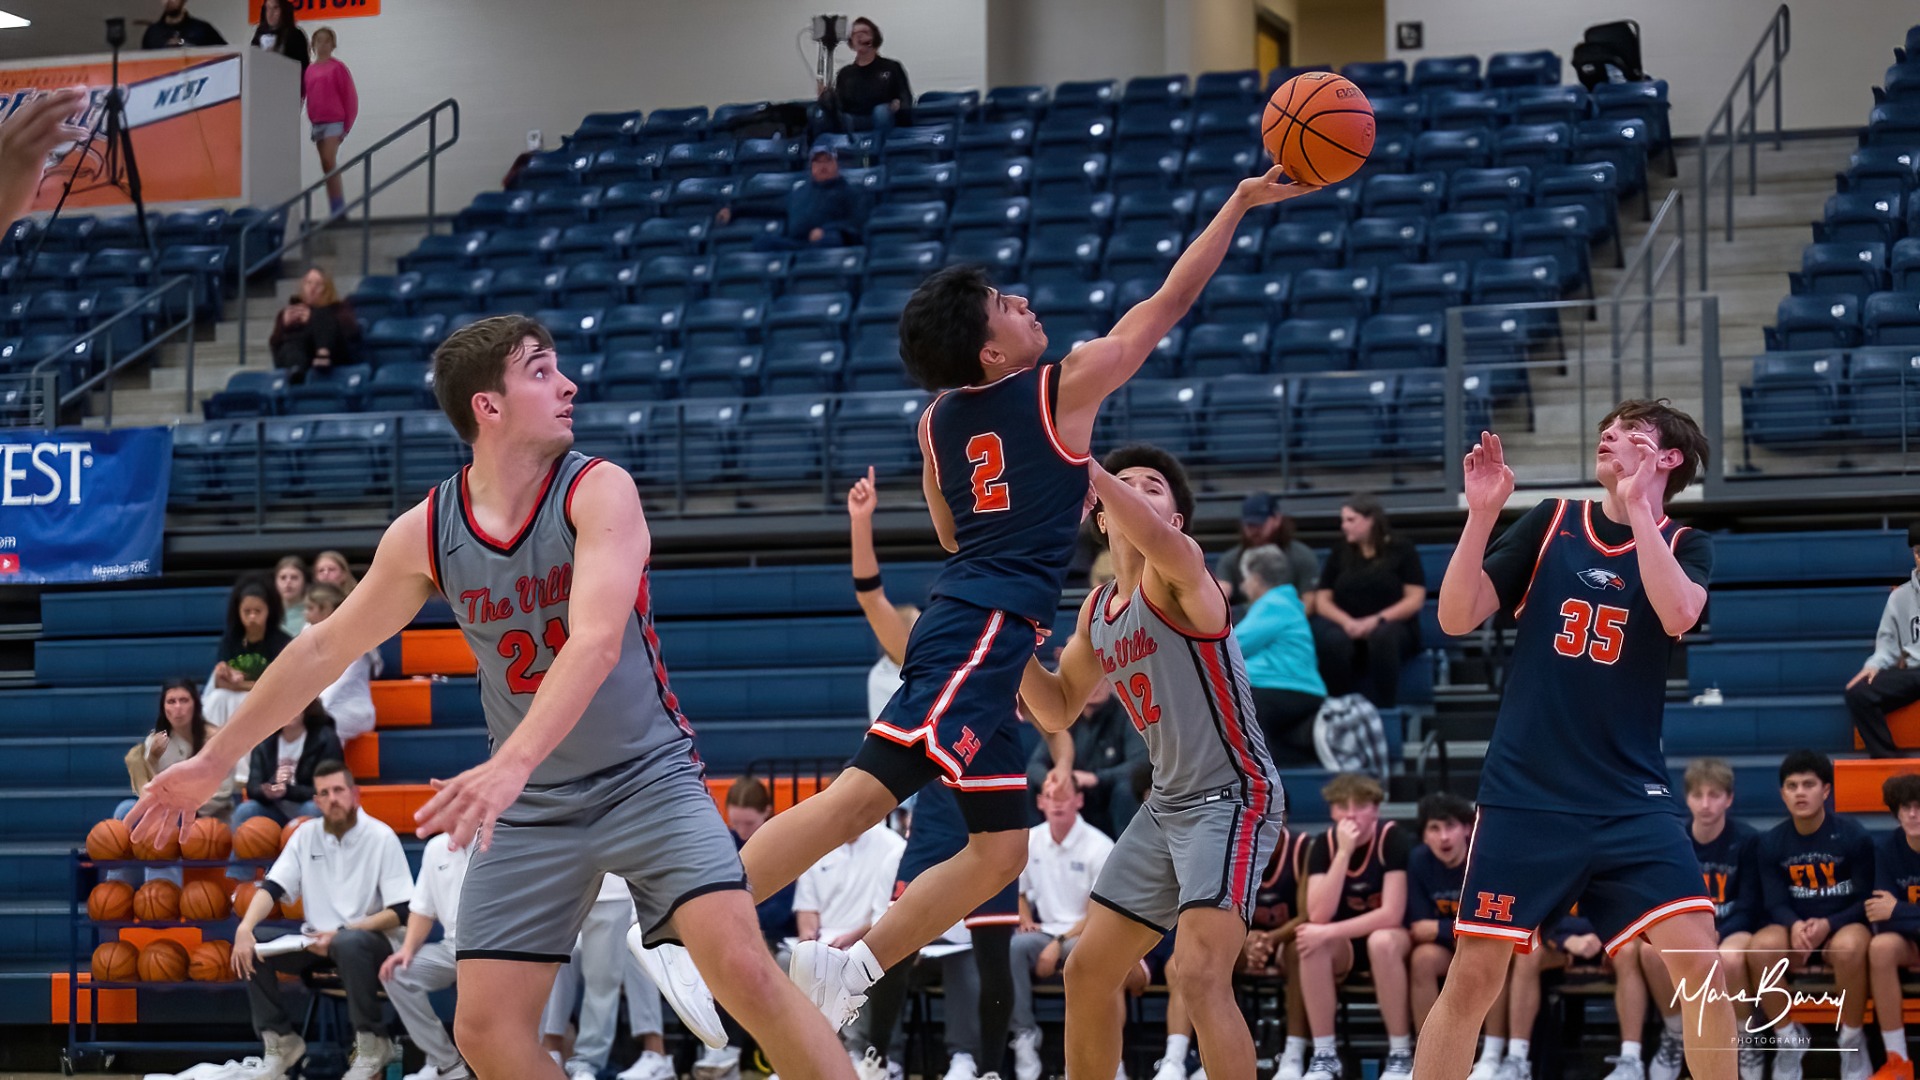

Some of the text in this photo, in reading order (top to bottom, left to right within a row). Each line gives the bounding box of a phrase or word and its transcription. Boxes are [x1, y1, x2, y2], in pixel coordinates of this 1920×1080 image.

[153, 76, 210, 109] NEST
[965, 431, 1011, 514] 2
[459, 562, 574, 624] The Vill
[1114, 627, 1158, 668] Ville
[1553, 598, 1630, 665] 35
[1115, 672, 1161, 732] 12
[952, 725, 982, 767] H
[1474, 891, 1516, 922] H
